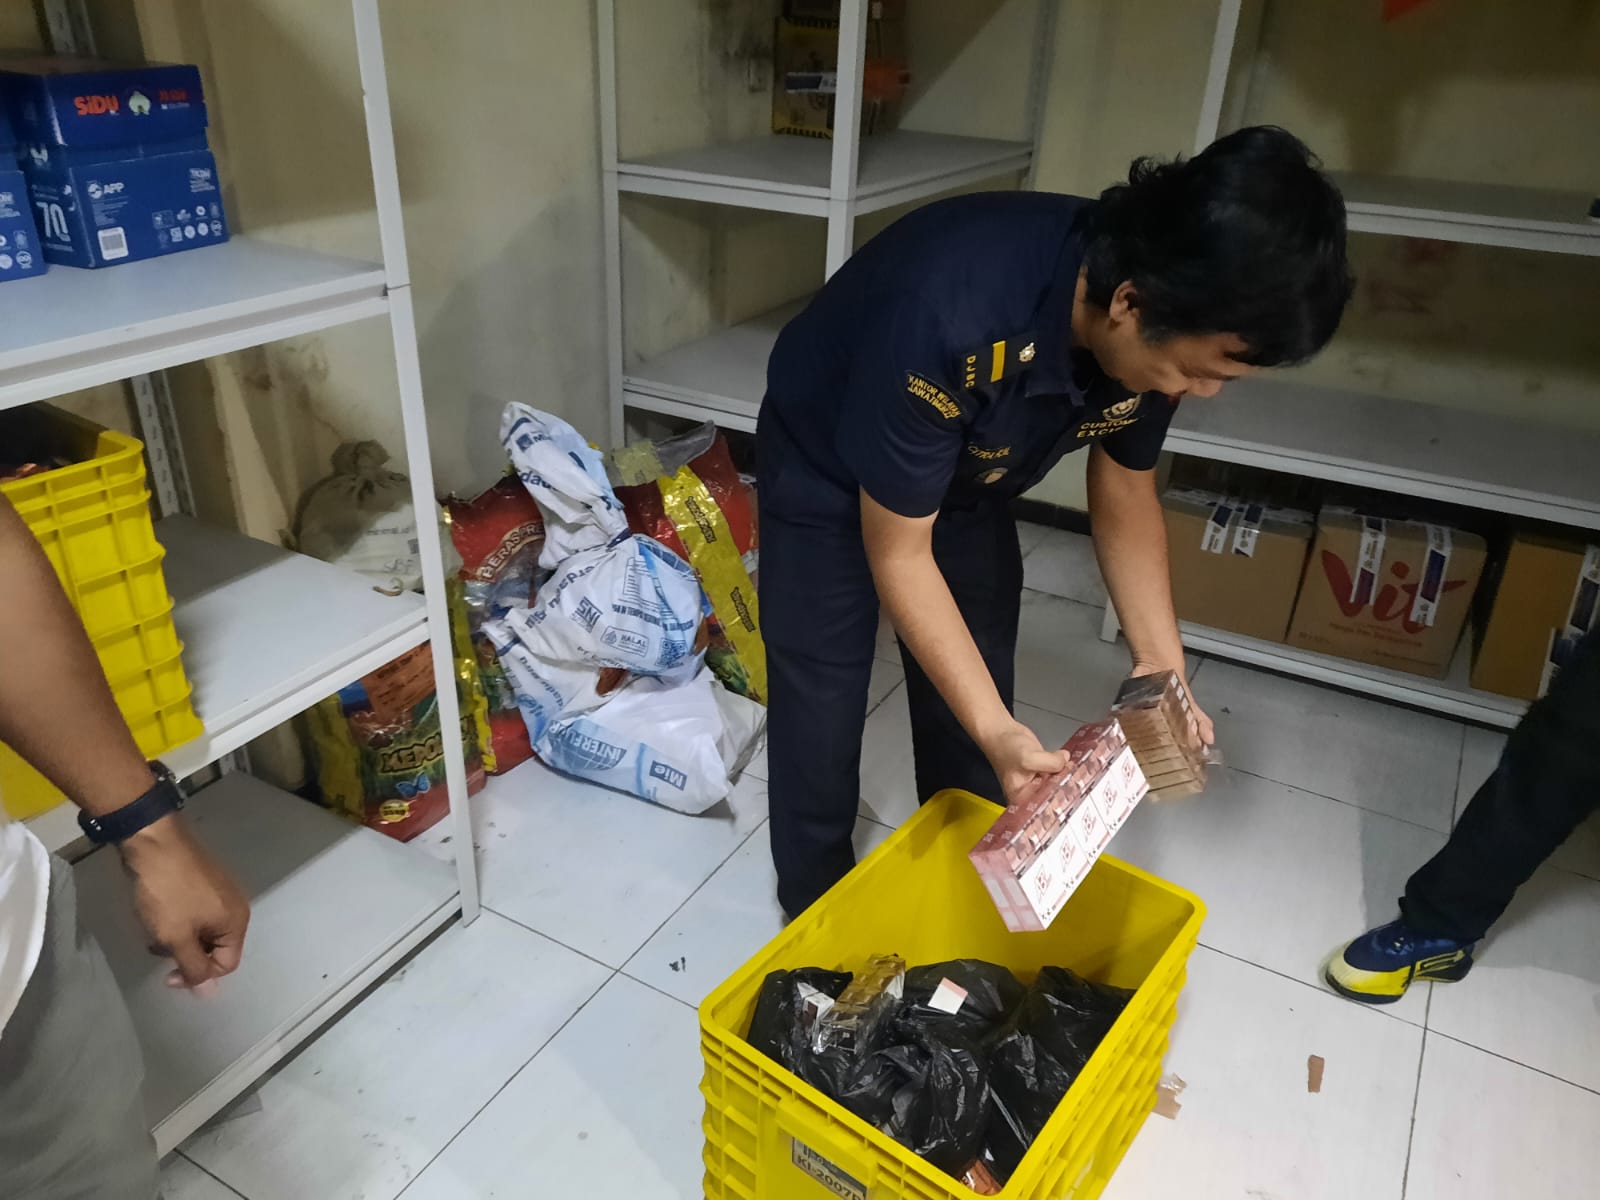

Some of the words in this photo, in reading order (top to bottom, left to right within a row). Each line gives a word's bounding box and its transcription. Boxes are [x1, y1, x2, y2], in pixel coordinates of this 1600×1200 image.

[103, 182, 125, 195] APP
[36, 201, 71, 242] 70
[907, 374, 939, 396] KANTOR
[1080, 418, 1140, 430] CUSTOM
[481, 530, 522, 579] BERAS
[576, 598, 601, 627] SNI
[654, 763, 685, 789] Mie
